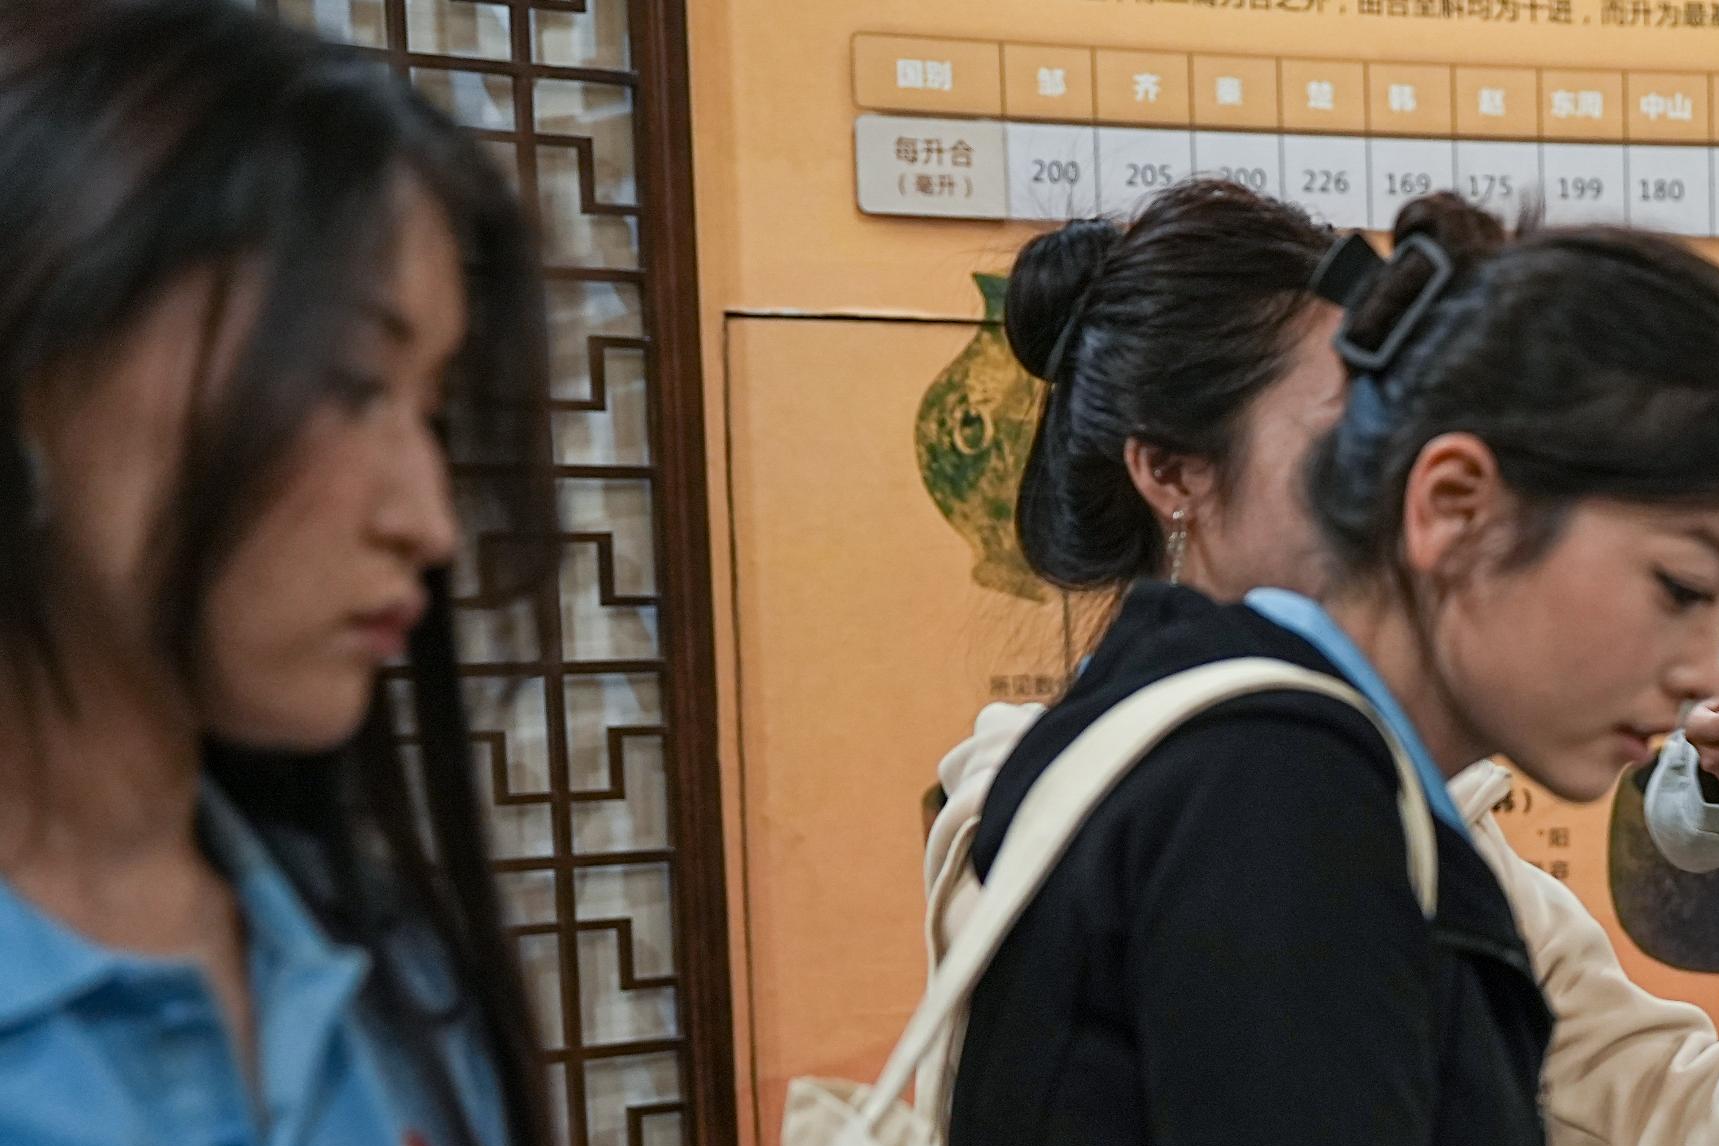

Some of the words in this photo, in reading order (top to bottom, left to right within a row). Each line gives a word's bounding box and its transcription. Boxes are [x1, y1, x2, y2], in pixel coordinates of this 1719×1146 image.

[1133, 73, 1161, 103] 齐
[1551, 90, 1604, 119] 东周
[1639, 91, 1692, 121] 中山
[895, 136, 974, 168] 每升合
[1032, 159, 1080, 185] 200
[1125, 163, 1173, 188] 205
[1303, 169, 1350, 194] 226
[1387, 172, 1432, 195] 169
[1470, 174, 1514, 199] 175
[1559, 176, 1604, 200] 199
[1639, 178, 1685, 202] 180
